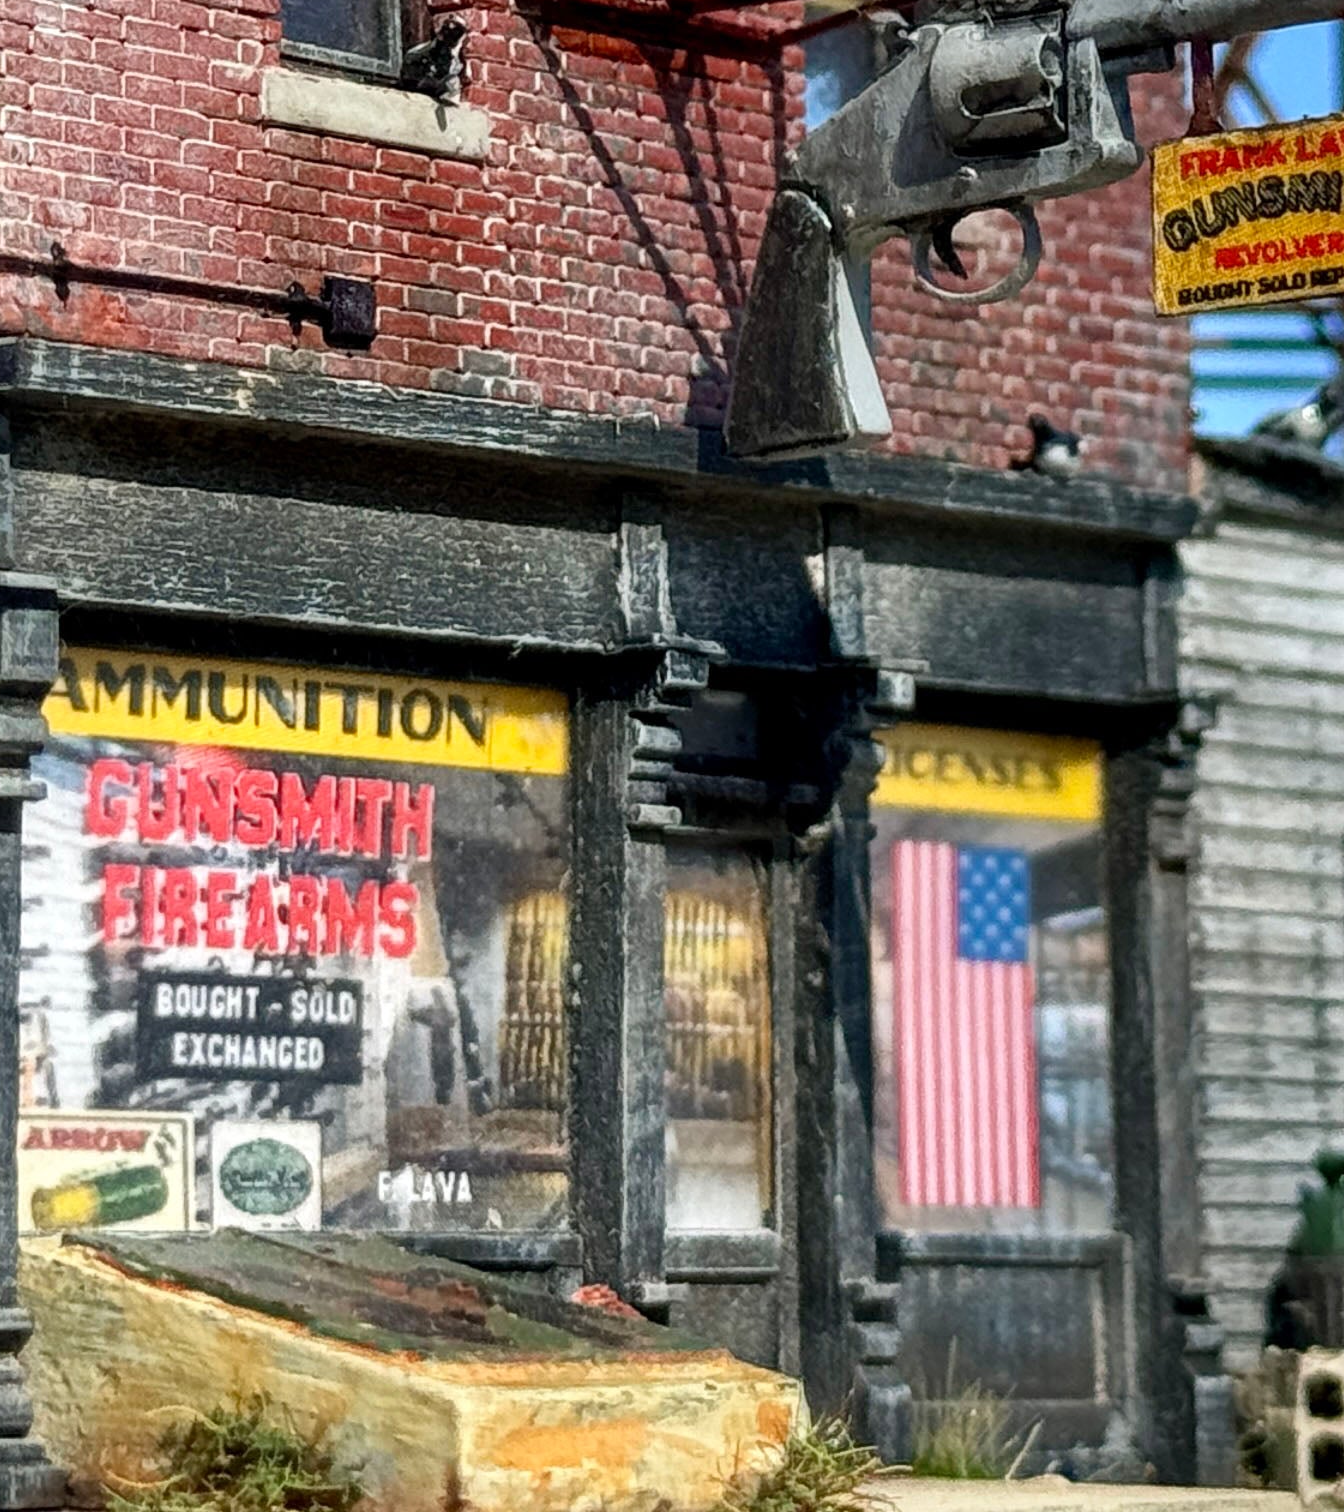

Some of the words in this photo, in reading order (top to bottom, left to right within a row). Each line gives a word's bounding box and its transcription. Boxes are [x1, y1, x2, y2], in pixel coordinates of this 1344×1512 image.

[1179, 141, 1287, 181] FRANK
[1178, 280, 1254, 306] BOUGHT
[1256, 272, 1306, 295] SOLD
[51, 657, 489, 748] AMMUNITION
[884, 744, 1062, 792] ICENSES
[84, 758, 436, 862] GUNSMITH
[101, 863, 421, 961] FIREARMS
[156, 982, 260, 1020] BOUGHT
[290, 988, 356, 1025] SOLD
[172, 1031, 325, 1071] EXCHANGED
[404, 1169, 473, 1203] LAVA
